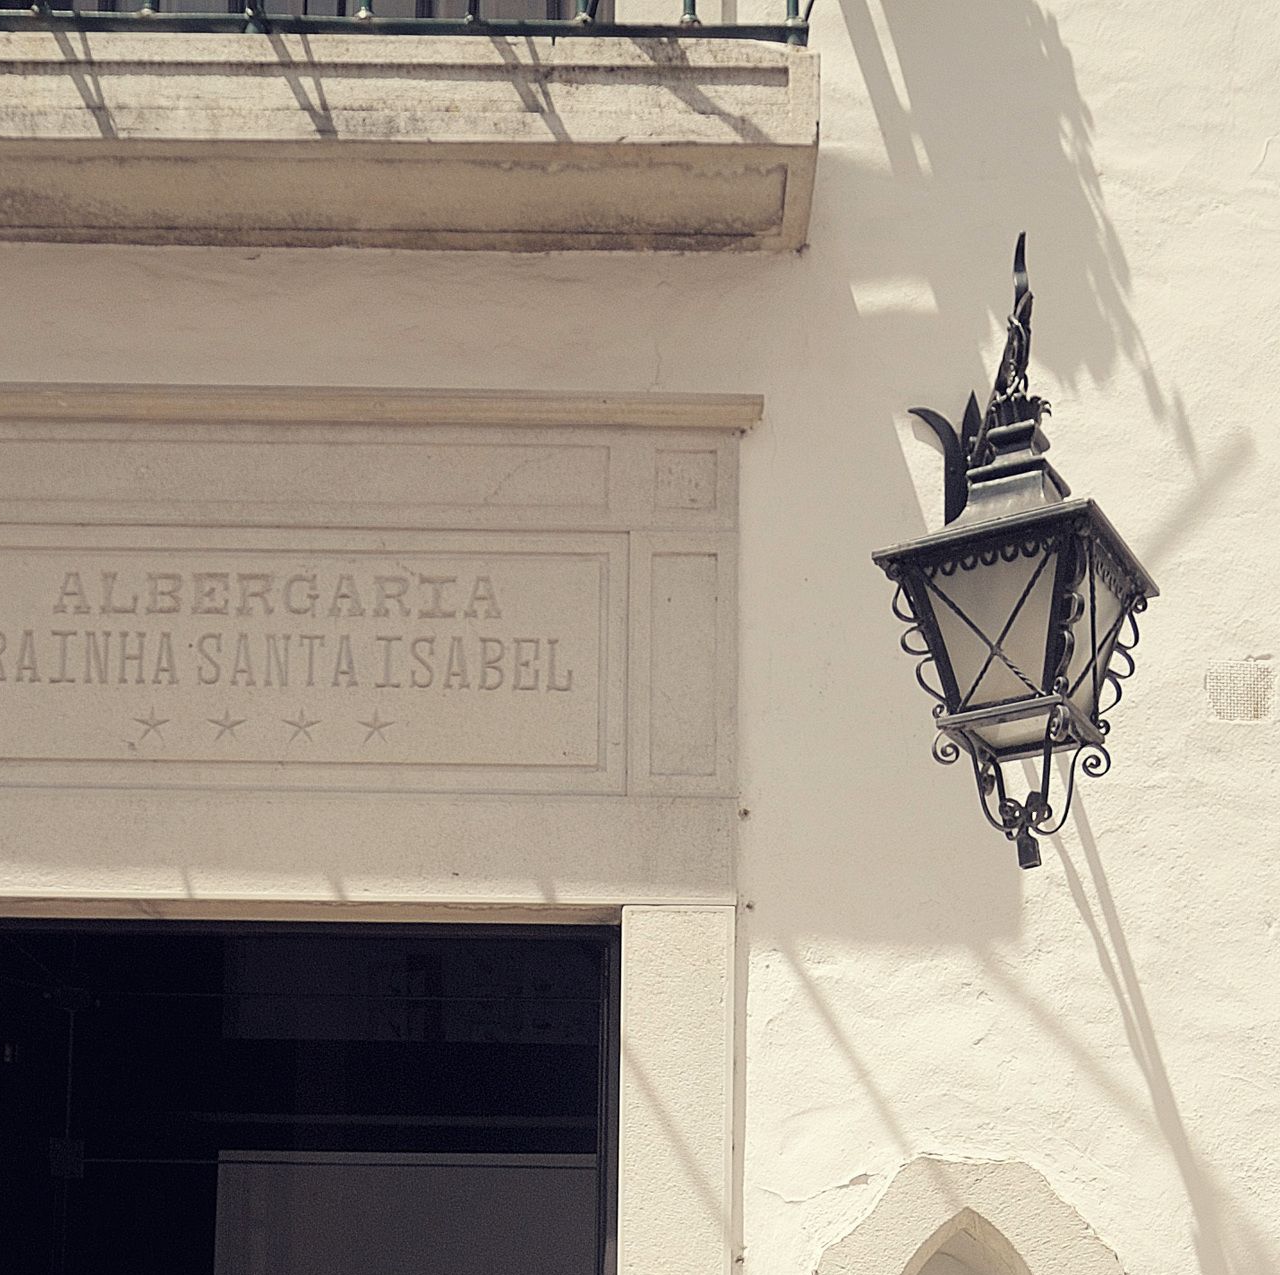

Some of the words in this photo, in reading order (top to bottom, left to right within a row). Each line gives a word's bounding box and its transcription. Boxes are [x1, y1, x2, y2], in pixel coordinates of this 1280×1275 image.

[52, 571, 503, 620] ALBERGARIA
[195, 632, 360, 689] SANTA
[374, 635, 574, 692] ISABEL
